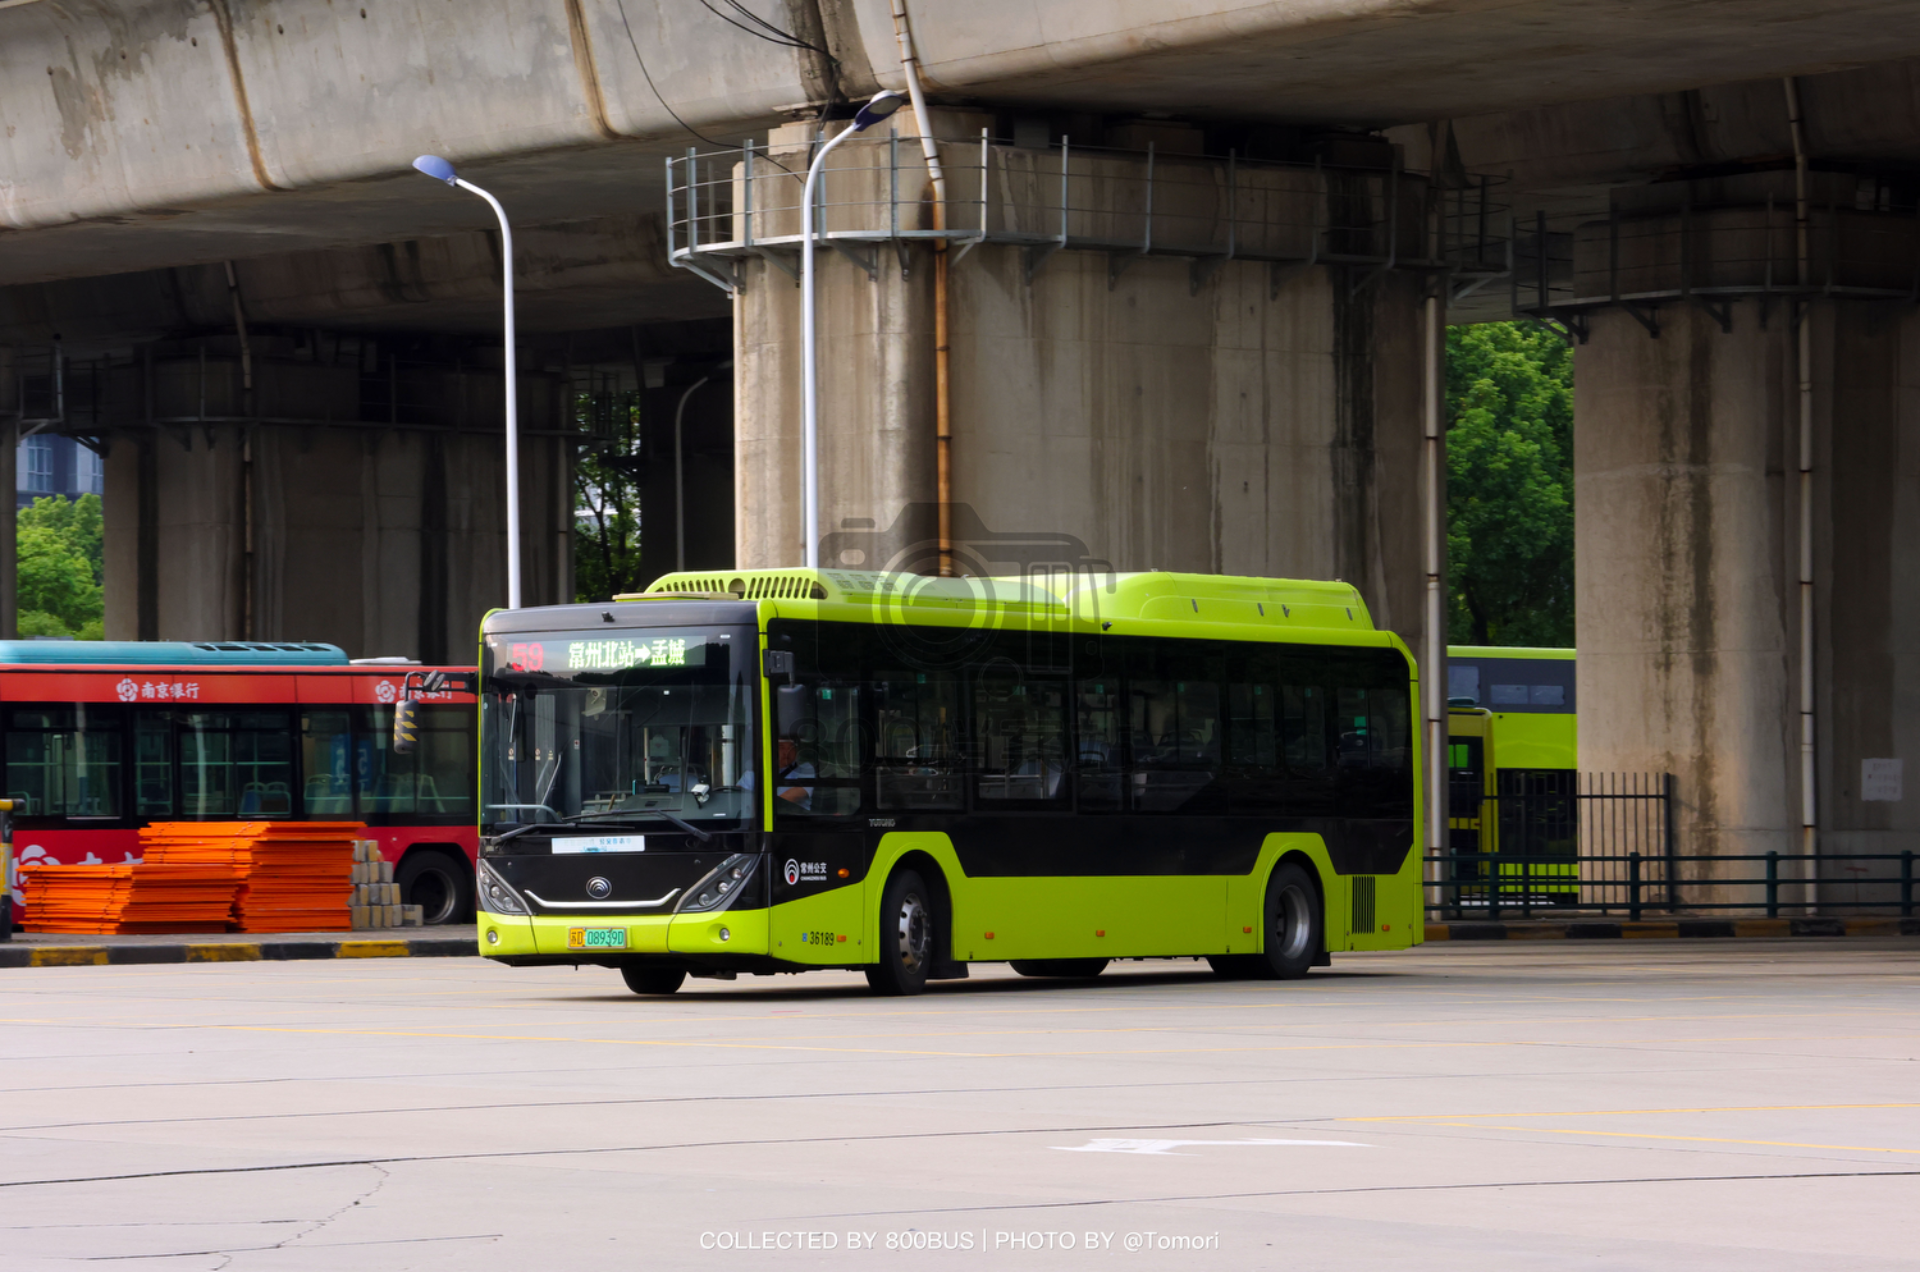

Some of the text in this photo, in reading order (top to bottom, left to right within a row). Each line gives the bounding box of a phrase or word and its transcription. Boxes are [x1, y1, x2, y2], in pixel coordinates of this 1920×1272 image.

[512, 643, 543, 671] 59
[141, 681, 200, 699] 南京银行
[809, 931, 835, 946] 36189
